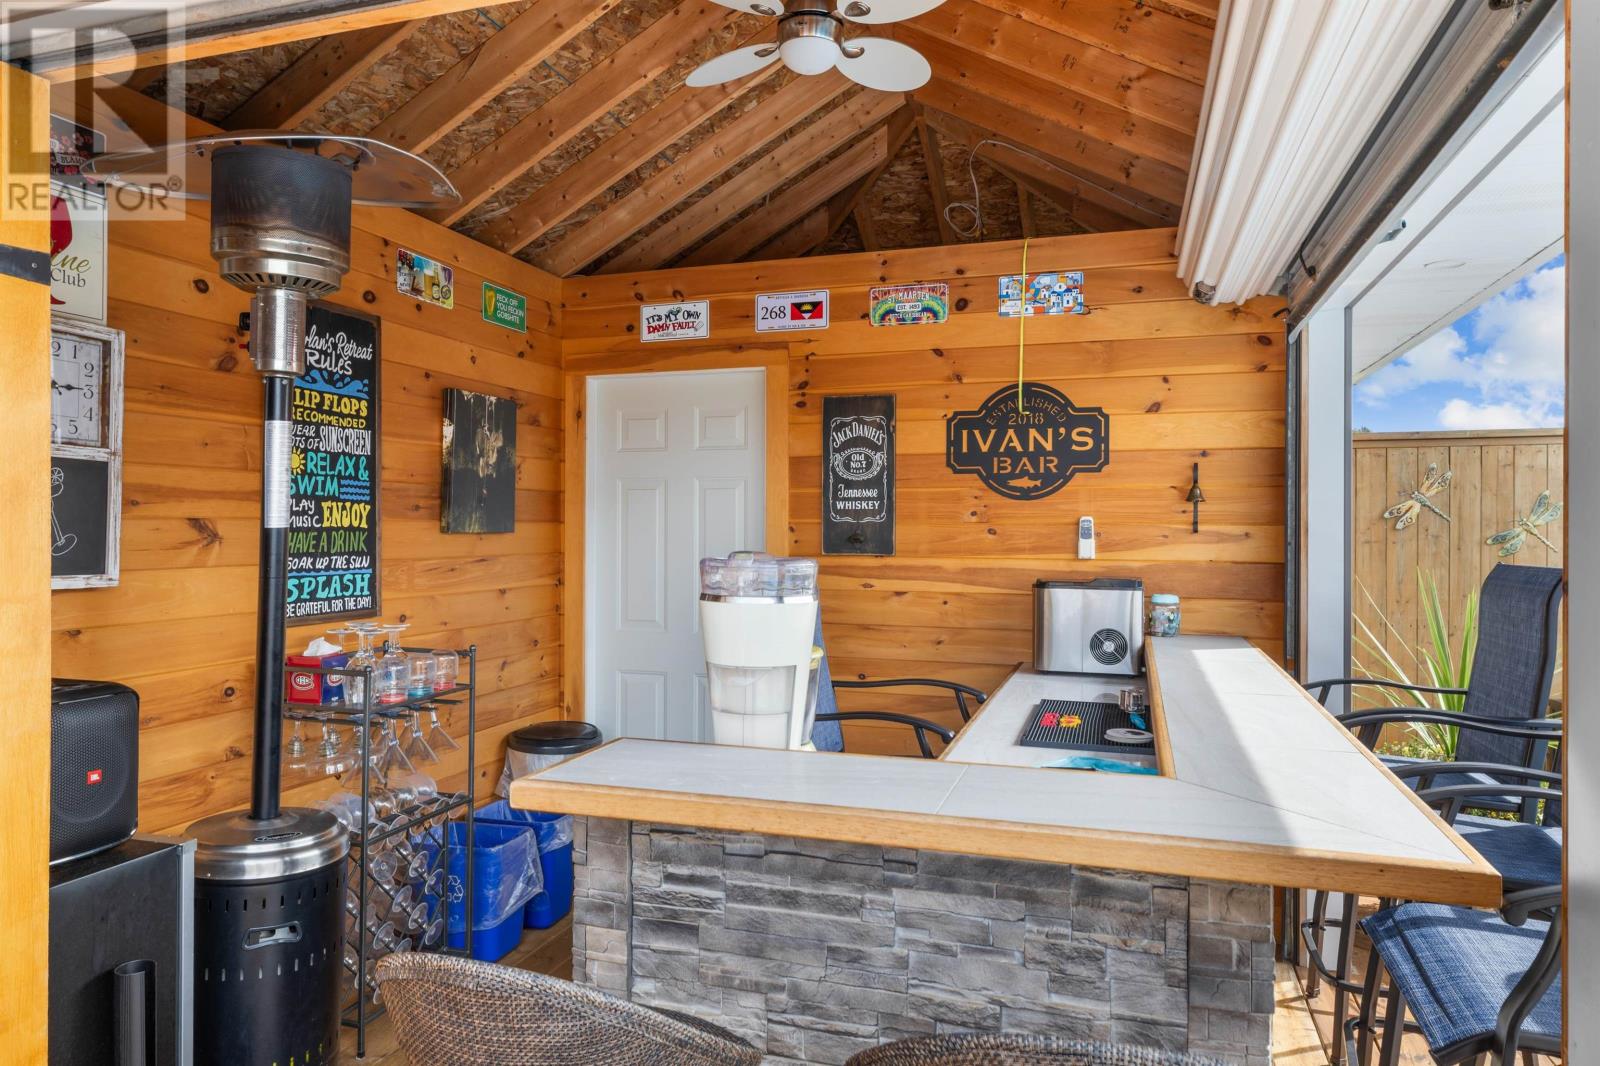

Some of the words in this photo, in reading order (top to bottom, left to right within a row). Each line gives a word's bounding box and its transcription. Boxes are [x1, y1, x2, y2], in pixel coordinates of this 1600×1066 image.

[51, 268, 86, 288] Club
[898, 291, 930, 301] MAARTEN
[496, 302, 508, 311] YOU
[761, 304, 787, 320] 268
[646, 314, 663, 325] IT'S
[664, 308, 679, 322] MY
[682, 309, 702, 321] OWN
[646, 322, 671, 335] DAMN
[671, 320, 697, 331] FAULT
[51, 341, 61, 357] 2
[305, 324, 335, 353] lan's
[335, 331, 374, 360] Retreat
[72, 344, 78, 360] 1
[84, 362, 95, 378] 2
[304, 348, 353, 376] Rules
[83, 384, 94, 400] 3
[293, 388, 321, 409] LIP
[322, 393, 368, 417] FLOPS
[83, 407, 93, 422] 4
[1008, 412, 1045, 426] 2018
[68, 419, 79, 435] 5
[832, 424, 853, 448] JACK
[851, 421, 886, 446] DANIEL'S
[307, 437, 321, 451] OF
[320, 425, 373, 456] SUNSCREEN
[961, 426, 1096, 454] IVAN'S
[851, 453, 865, 461] Old
[993, 456, 1059, 474] BAR
[306, 451, 356, 477] RELAX
[358, 456, 369, 481] &
[838, 484, 878, 498] Tennessee
[836, 500, 881, 510] WHISKEY
[321, 500, 371, 529] ENJOY
[288, 530, 318, 554] HAVE
[320, 530, 328, 553] A
[330, 529, 368, 554] DRINK
[288, 556, 314, 570] SOAK
[315, 556, 330, 570] UP
[330, 555, 349, 569] THE
[349, 555, 370, 569] SUN
[286, 573, 371, 603] SPLASH
[296, 600, 331, 617] GRATEFUL
[331, 598, 344, 612] FOR
[344, 597, 357, 611] THE
[356, 595, 372, 609] DAY!
